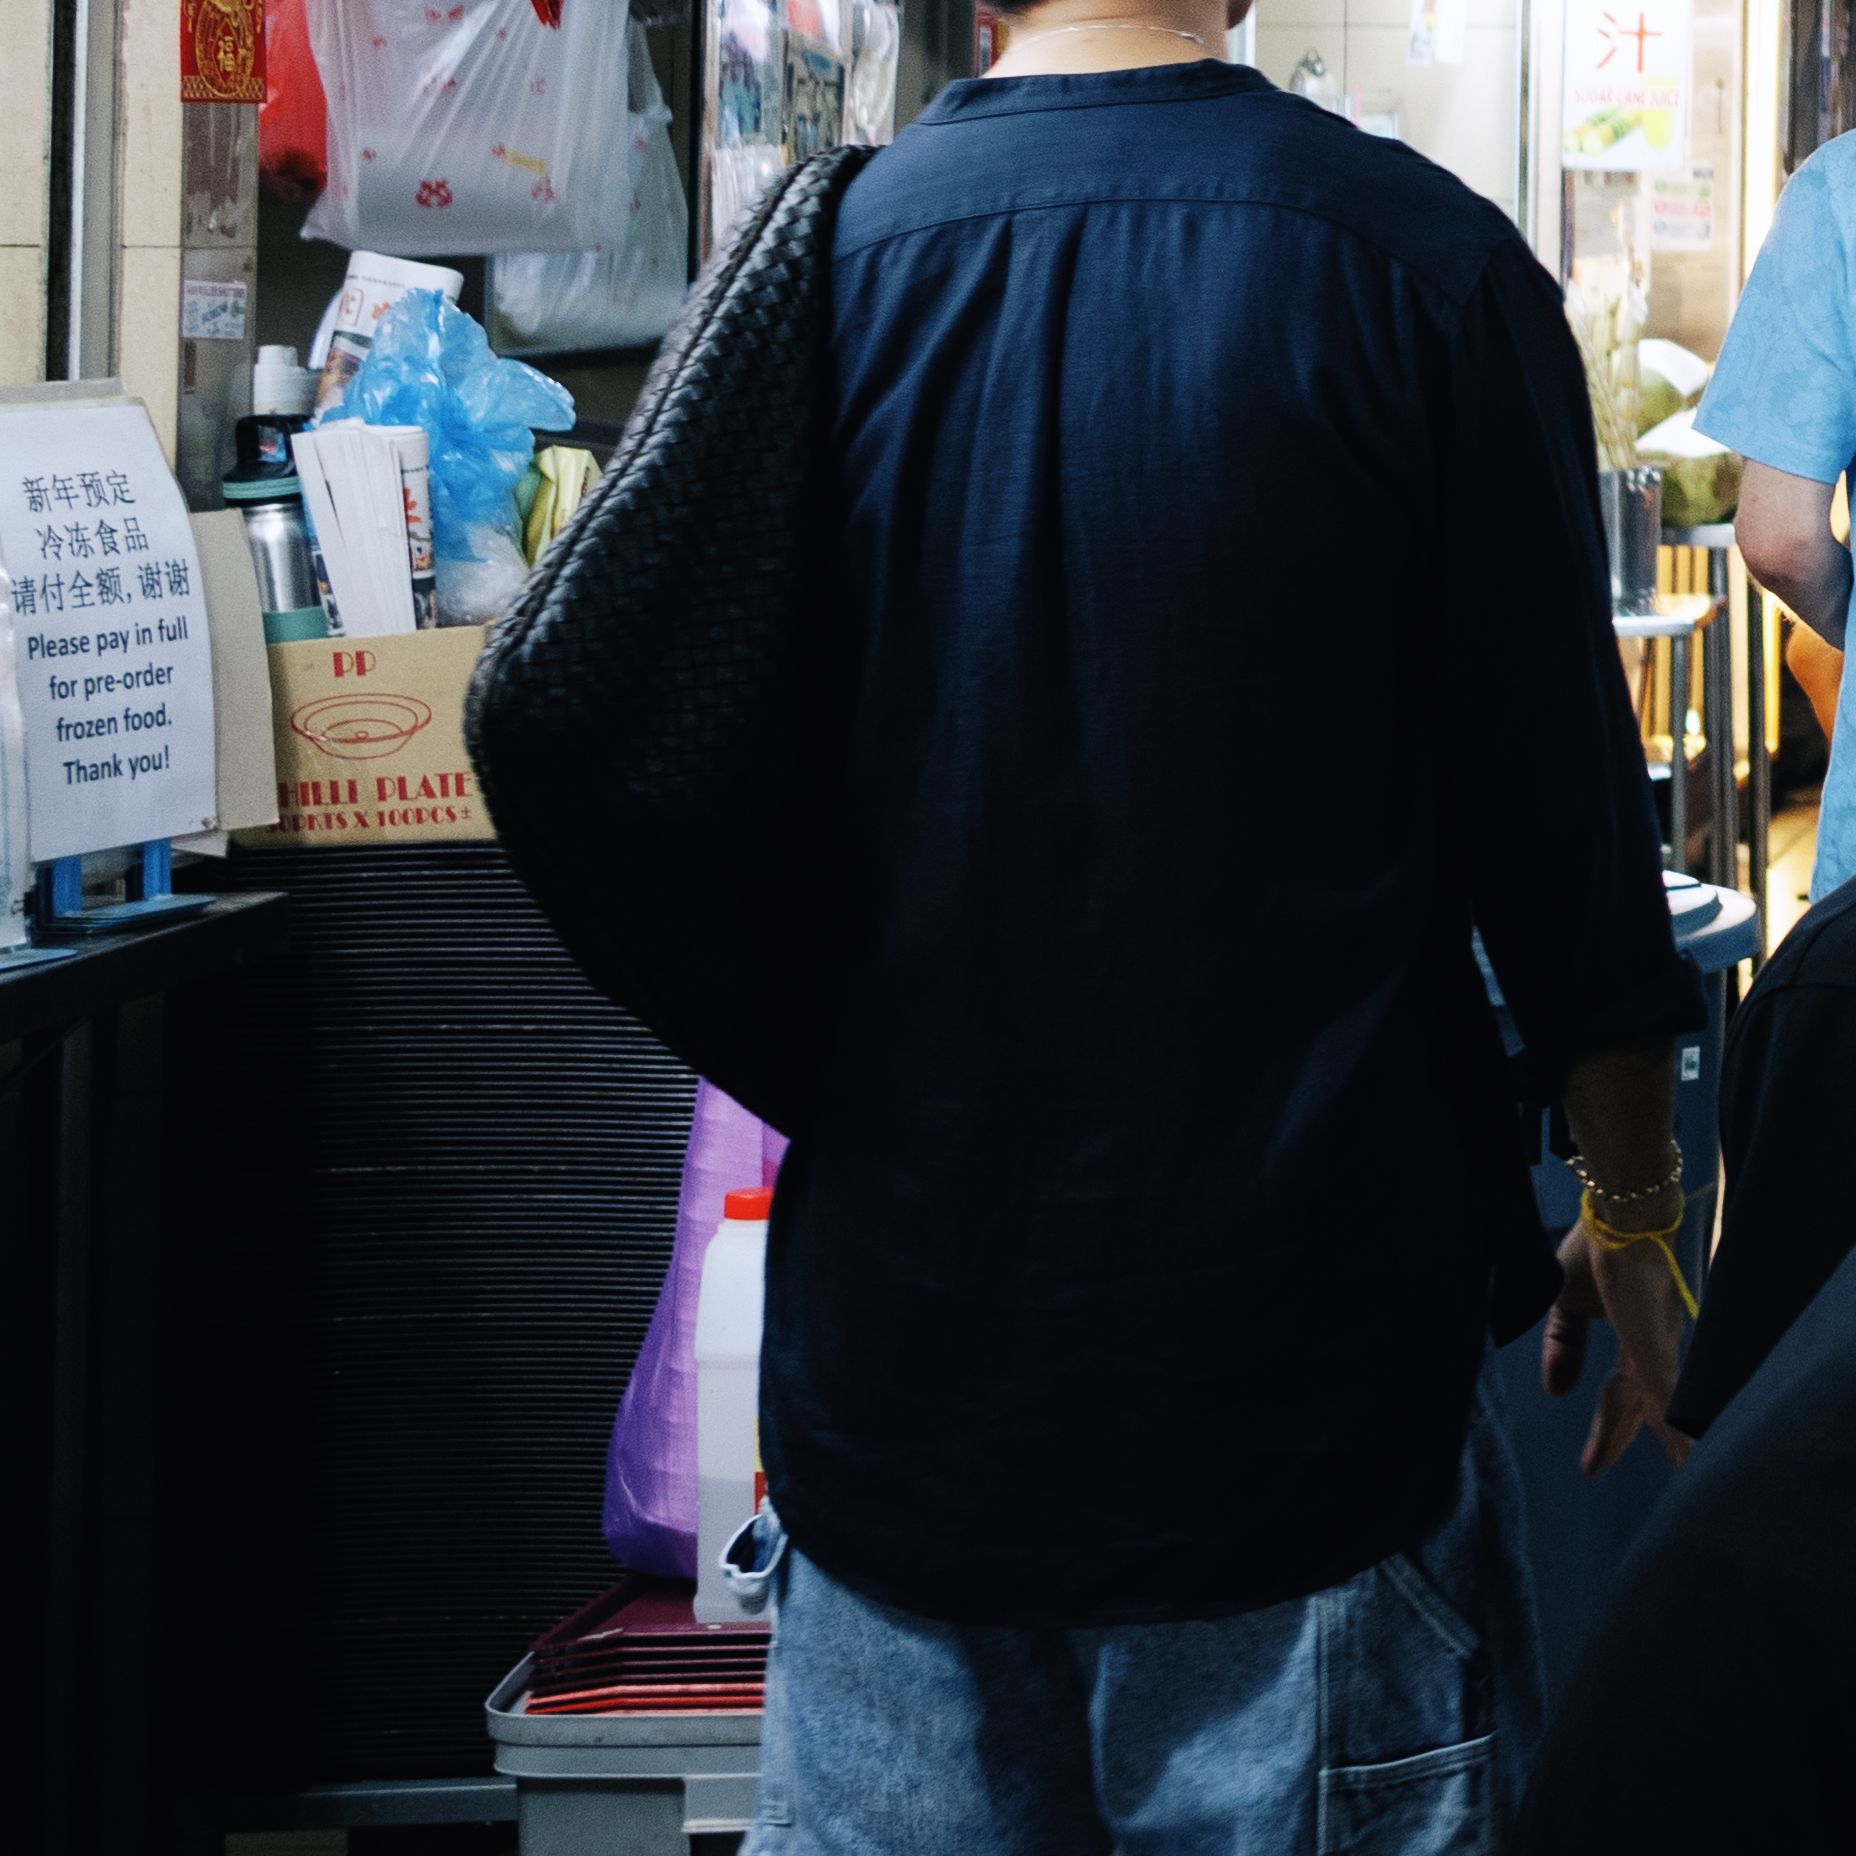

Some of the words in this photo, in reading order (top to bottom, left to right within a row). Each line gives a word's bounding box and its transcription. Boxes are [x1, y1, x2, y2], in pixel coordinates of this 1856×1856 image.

[22, 470, 136, 513] 新年预定
[35, 517, 150, 561] 冷冻食品
[28, 634, 90, 660] Please
[97, 631, 130, 658] pay
[136, 622, 152, 646] in
[158, 615, 189, 643] full
[50, 675, 77, 700] for
[84, 663, 174, 701] pre-order
[332, 650, 376, 677] PP
[57, 716, 118, 742] frozen
[124, 702, 172, 732] food.
[63, 752, 122, 785] Thank
[128, 745, 171, 780] you!
[277, 778, 359, 807] HILLI
[376, 772, 475, 803] PLATE
[353, 811, 369, 830] X
[377, 806, 457, 828] 100PCS
